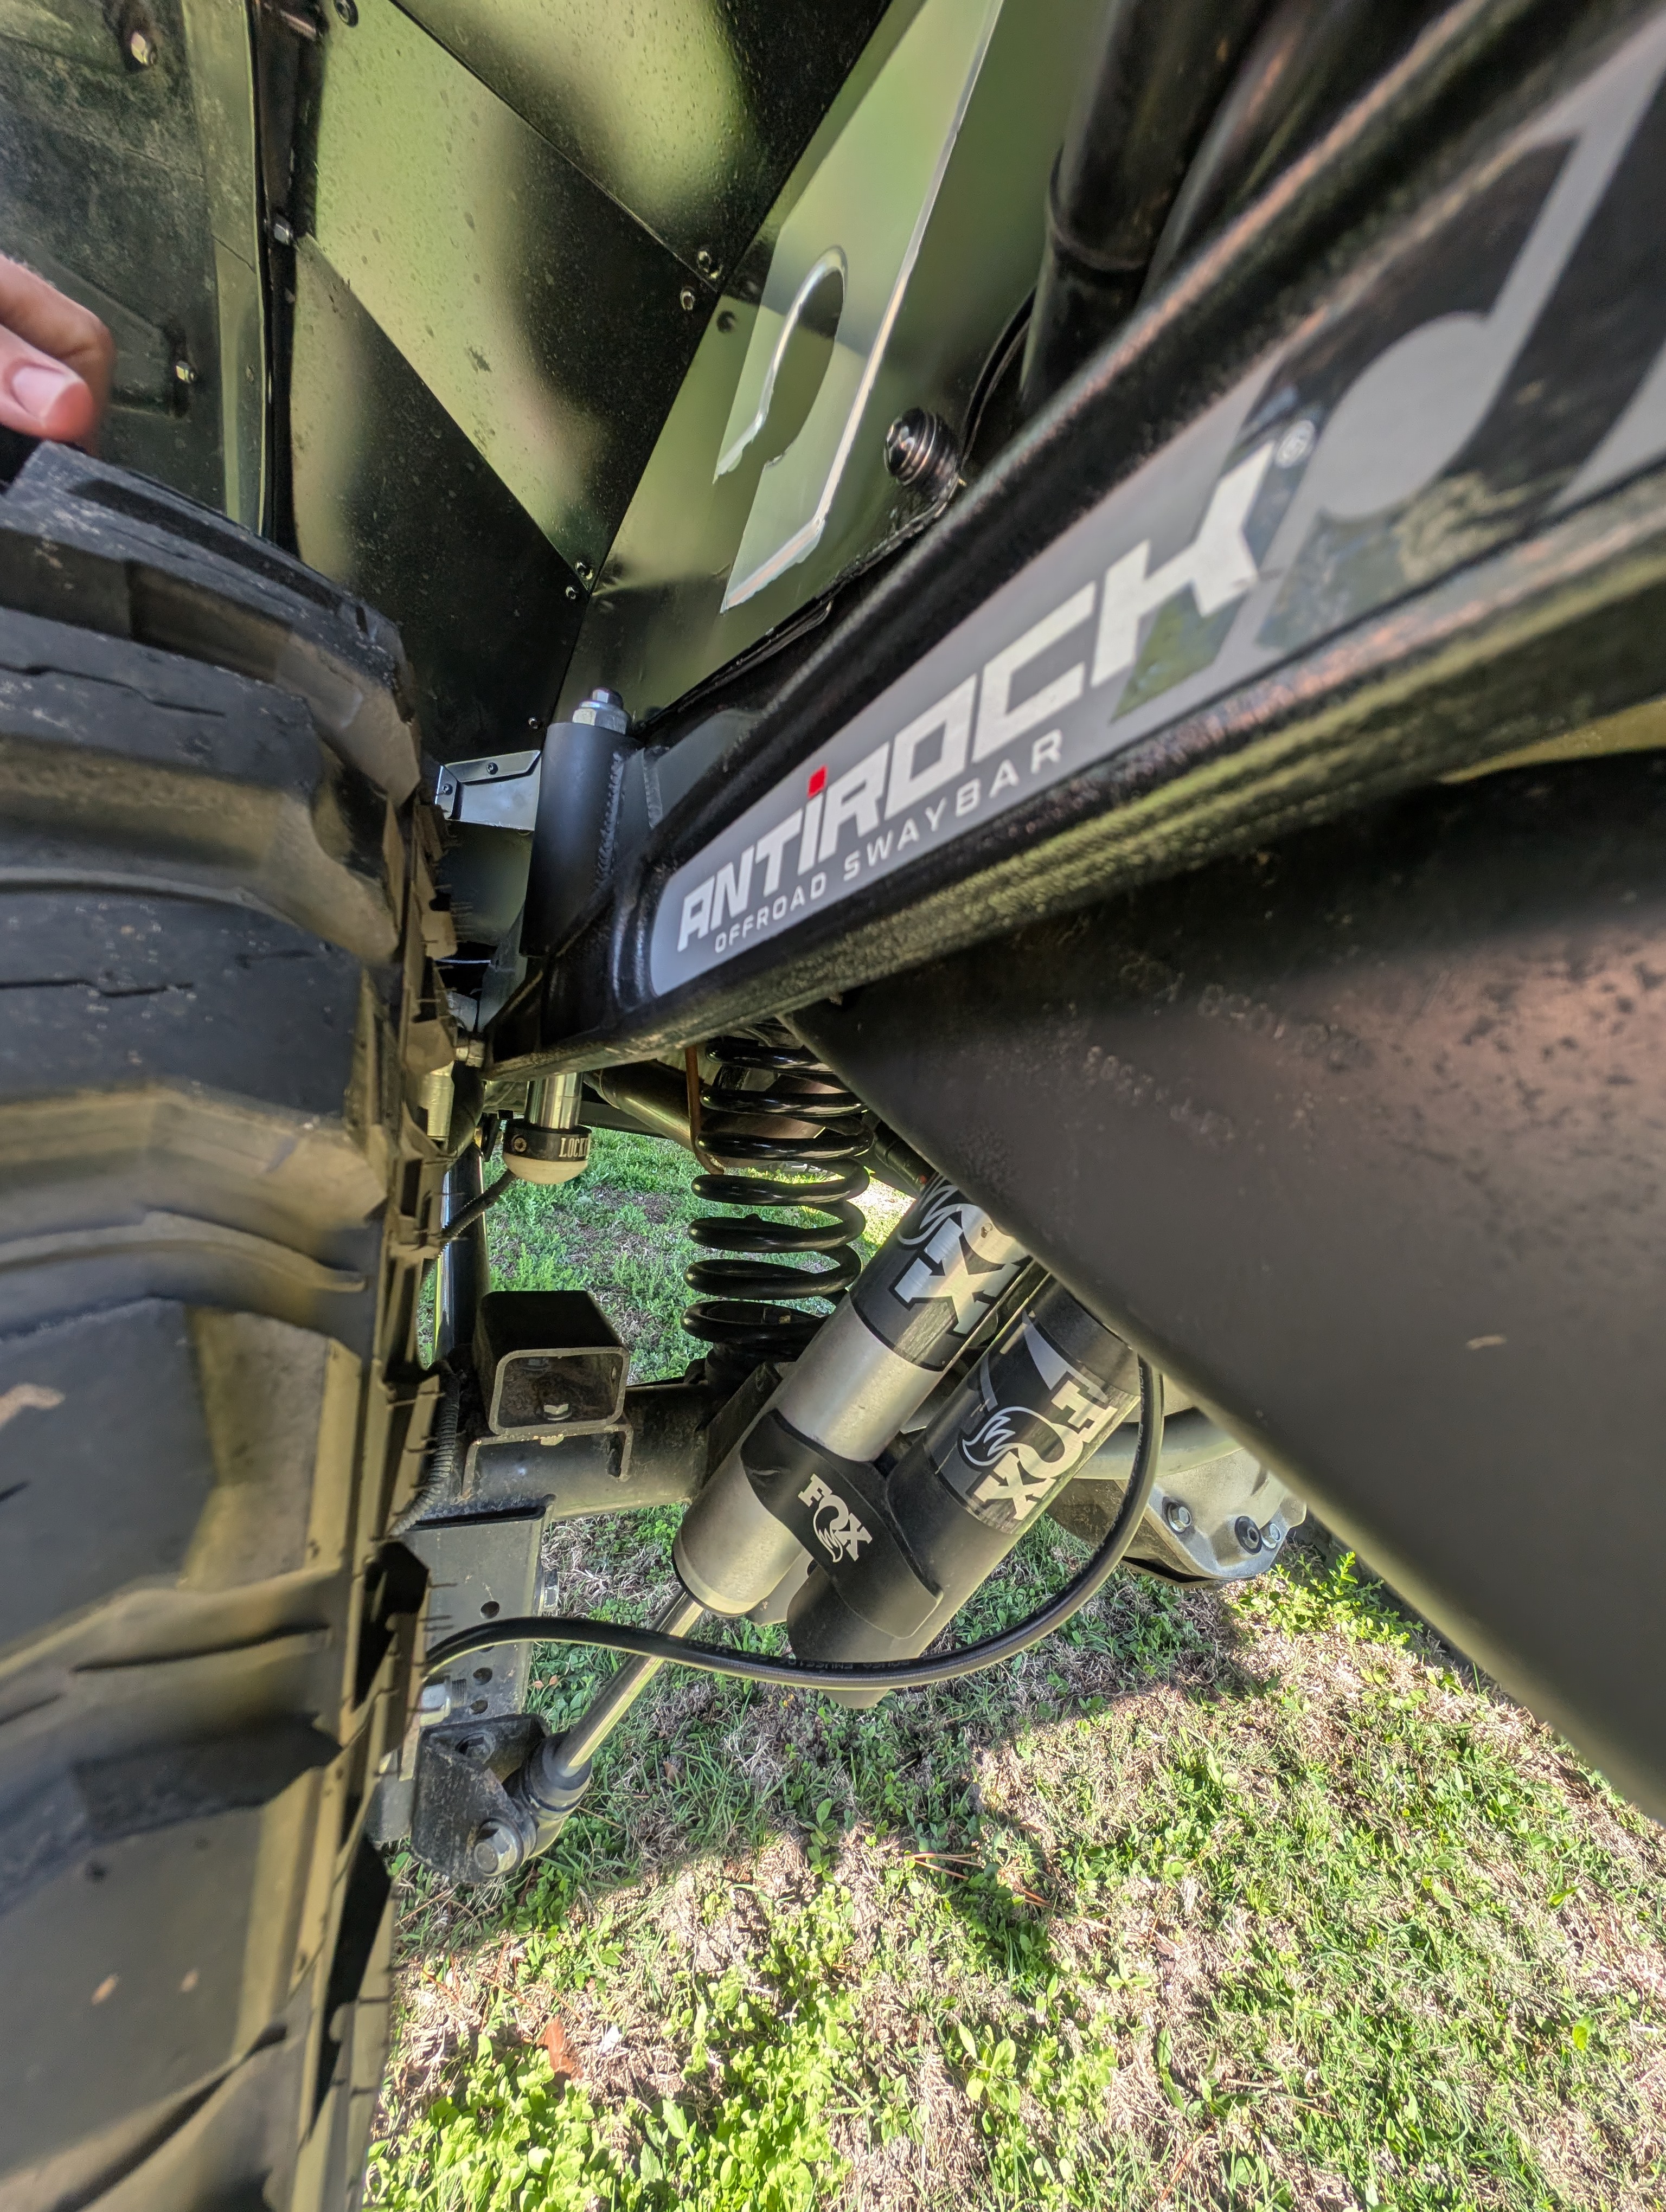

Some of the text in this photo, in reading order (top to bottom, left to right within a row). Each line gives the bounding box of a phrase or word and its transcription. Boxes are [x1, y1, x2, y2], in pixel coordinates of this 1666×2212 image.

[715, 729, 1062, 953] OFFROAD SWAYBAR
[895, 1173, 1030, 1334] OX
[798, 1473, 873, 1563] FOX
[962, 1380, 1118, 1521] FOX
